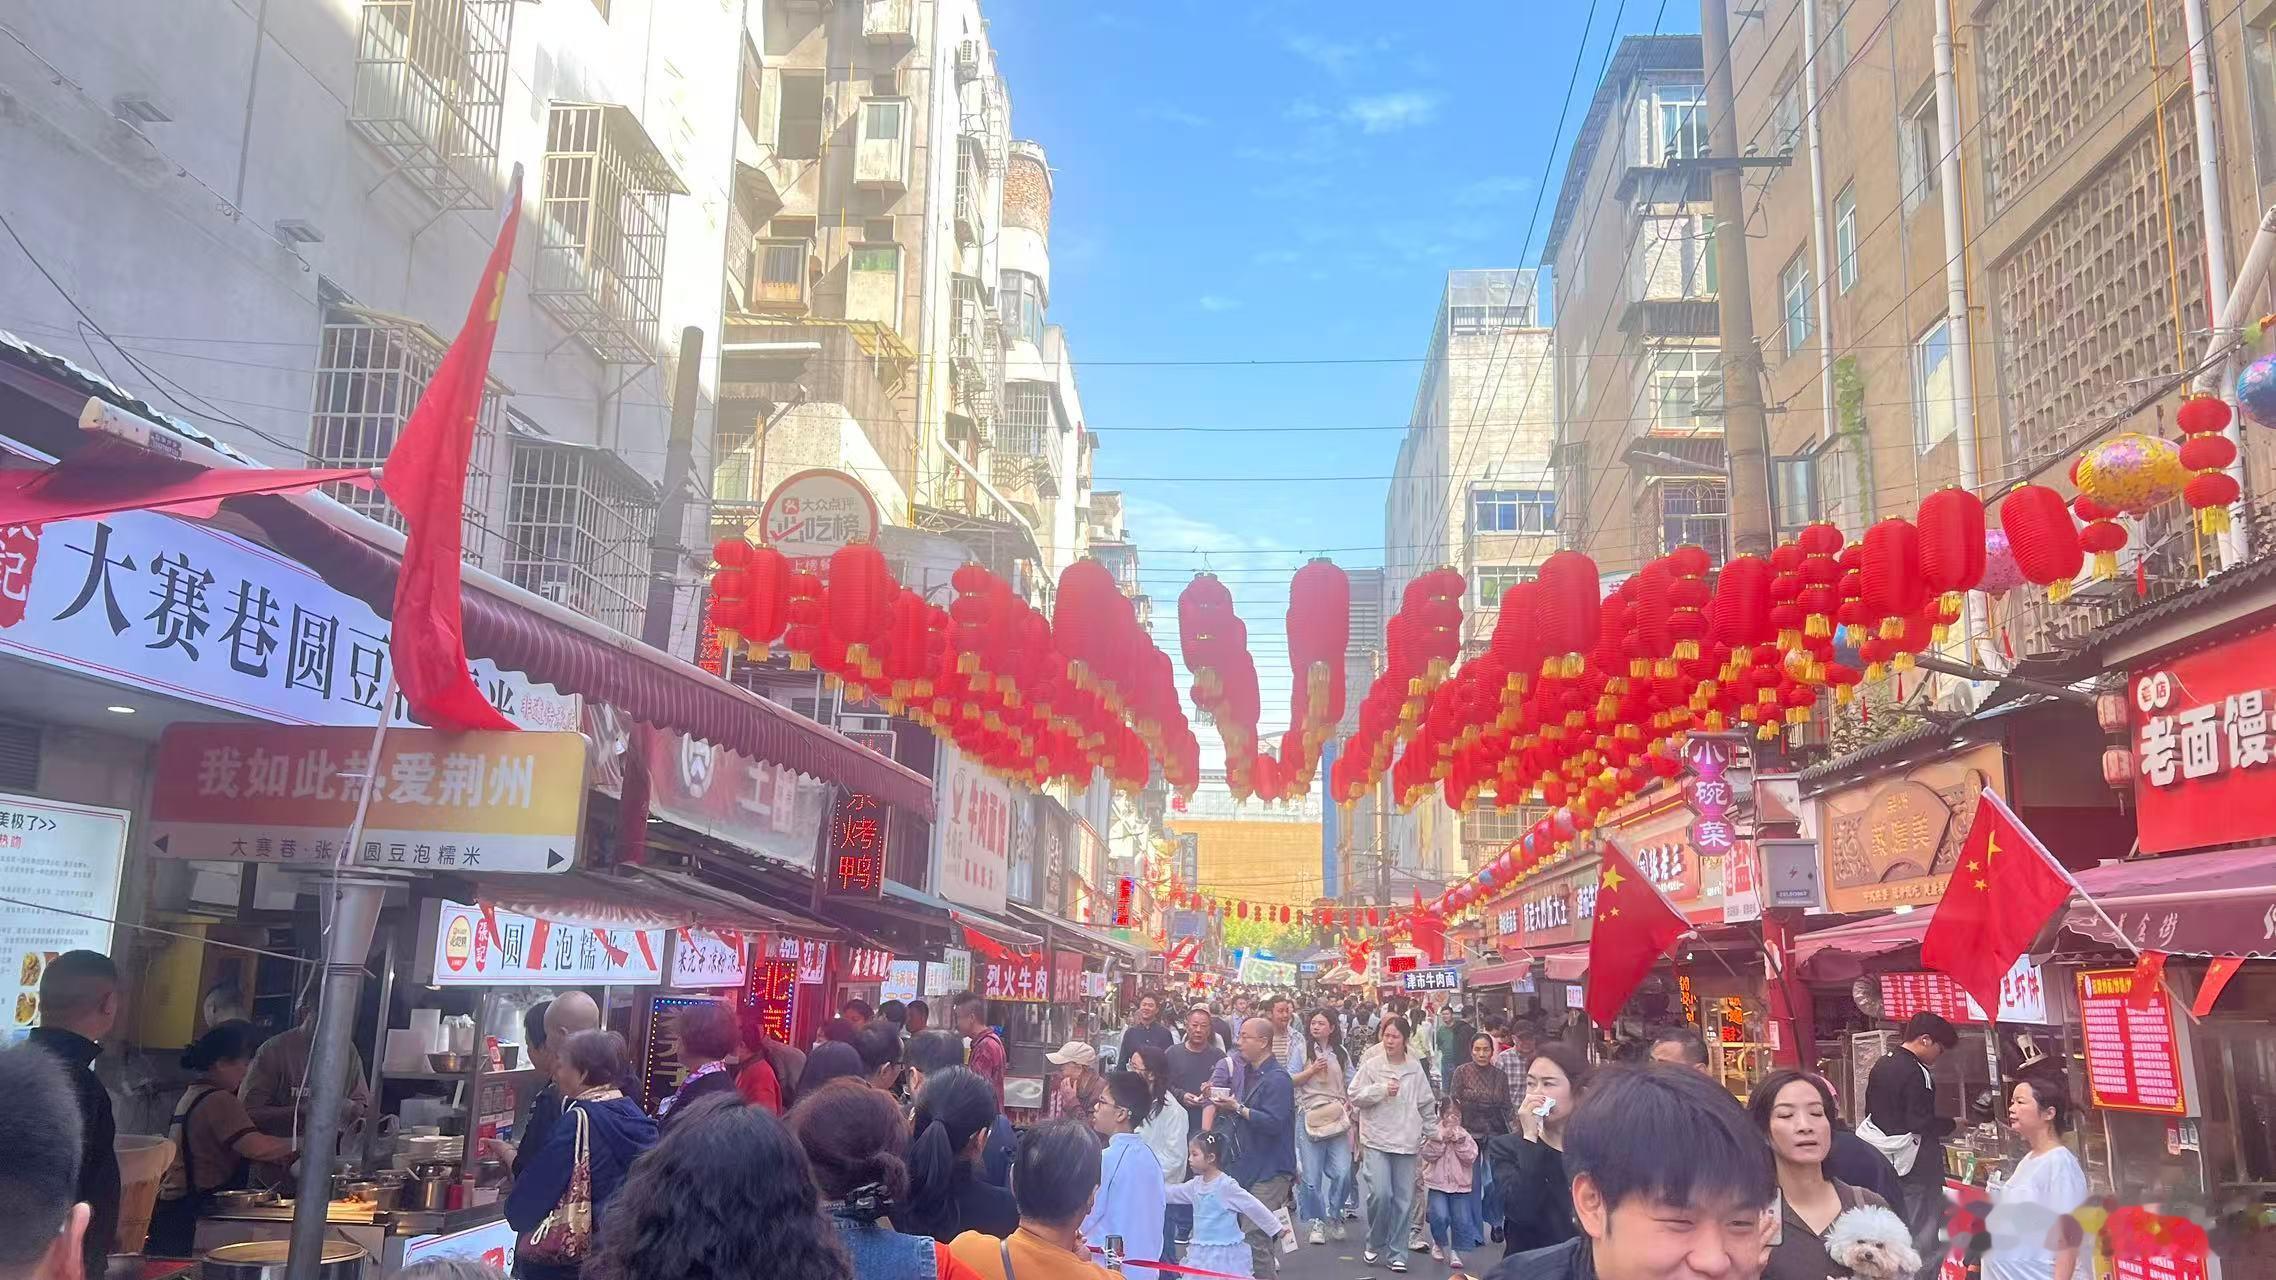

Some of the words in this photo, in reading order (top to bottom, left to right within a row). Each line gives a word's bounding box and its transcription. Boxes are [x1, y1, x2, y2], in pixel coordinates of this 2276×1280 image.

[770, 515, 859, 543] 必吃榜
[52, 522, 515, 720] 大赛巷圆豆米
[2140, 690, 2276, 787] 老面馒
[197, 748, 535, 808] 我如此热爱荆州
[1693, 741, 1732, 847] 小碗菜
[501, 923, 618, 971] 圆泡糯米
[986, 963, 1048, 999] 烈火牛肉
[1406, 971, 1456, 990] 津市牛肉面
